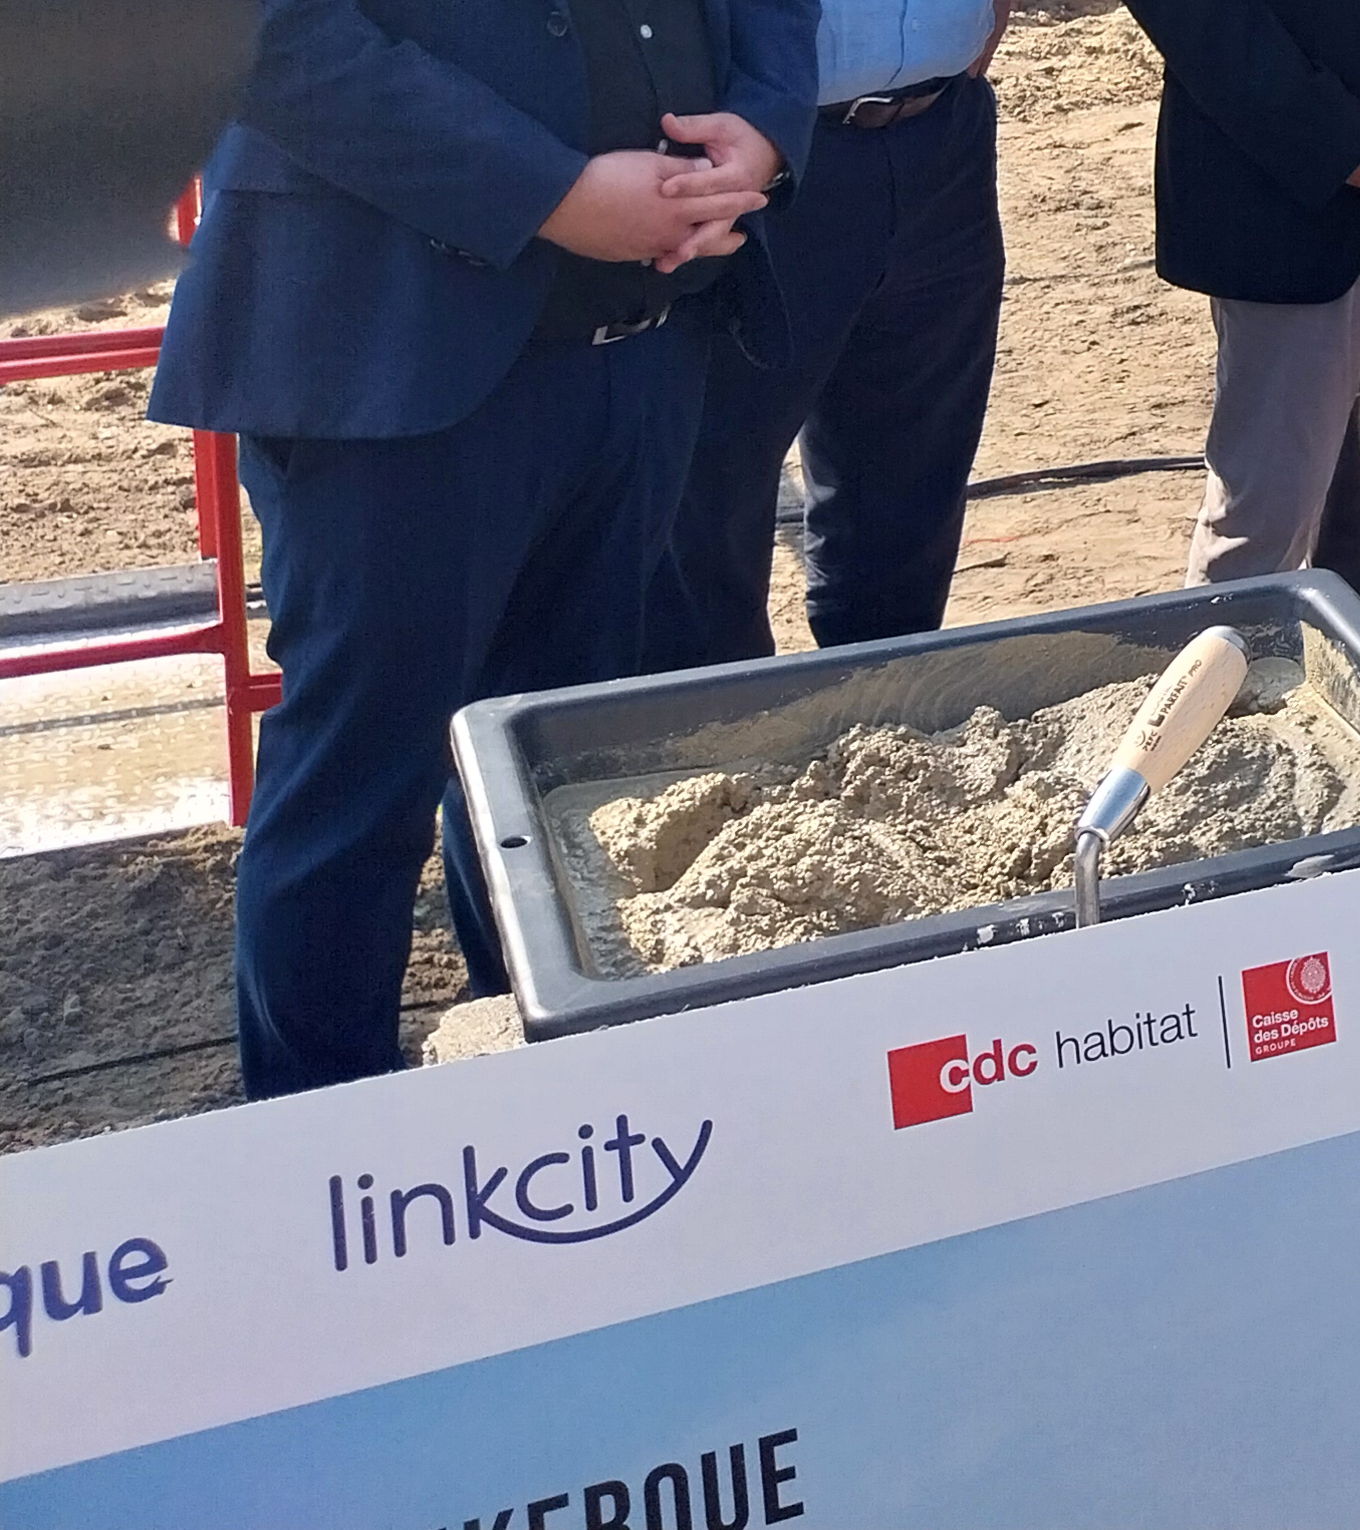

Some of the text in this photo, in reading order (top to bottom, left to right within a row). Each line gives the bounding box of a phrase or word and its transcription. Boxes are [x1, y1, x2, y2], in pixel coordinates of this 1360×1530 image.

[1252, 1009, 1299, 1028] Caisse
[1253, 1016, 1329, 1044] des Dépôts
[939, 1003, 1199, 1094] cdc habitat
[1255, 1038, 1296, 1055] GROUPE
[329, 1114, 713, 1271] linkcity
